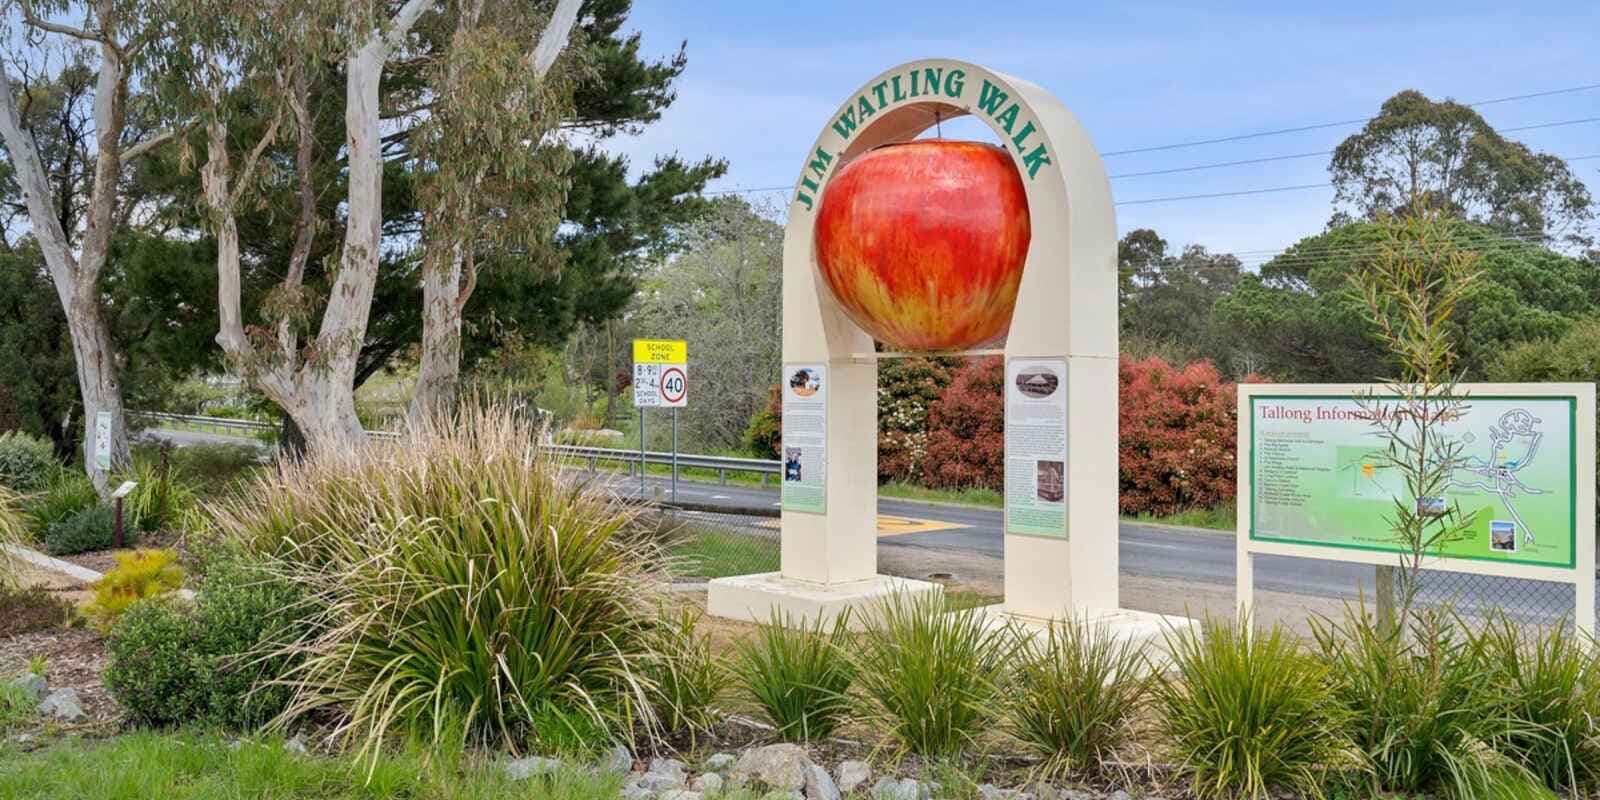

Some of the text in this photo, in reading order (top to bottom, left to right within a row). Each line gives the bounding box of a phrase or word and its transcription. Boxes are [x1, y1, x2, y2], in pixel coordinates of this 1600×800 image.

[797, 67, 1052, 212] JIM WATLING WALK
[647, 344, 675, 352] SCHOOL
[650, 353, 670, 361] ZONE
[665, 377, 683, 393] 40
[1259, 405, 1312, 424] Tallong
